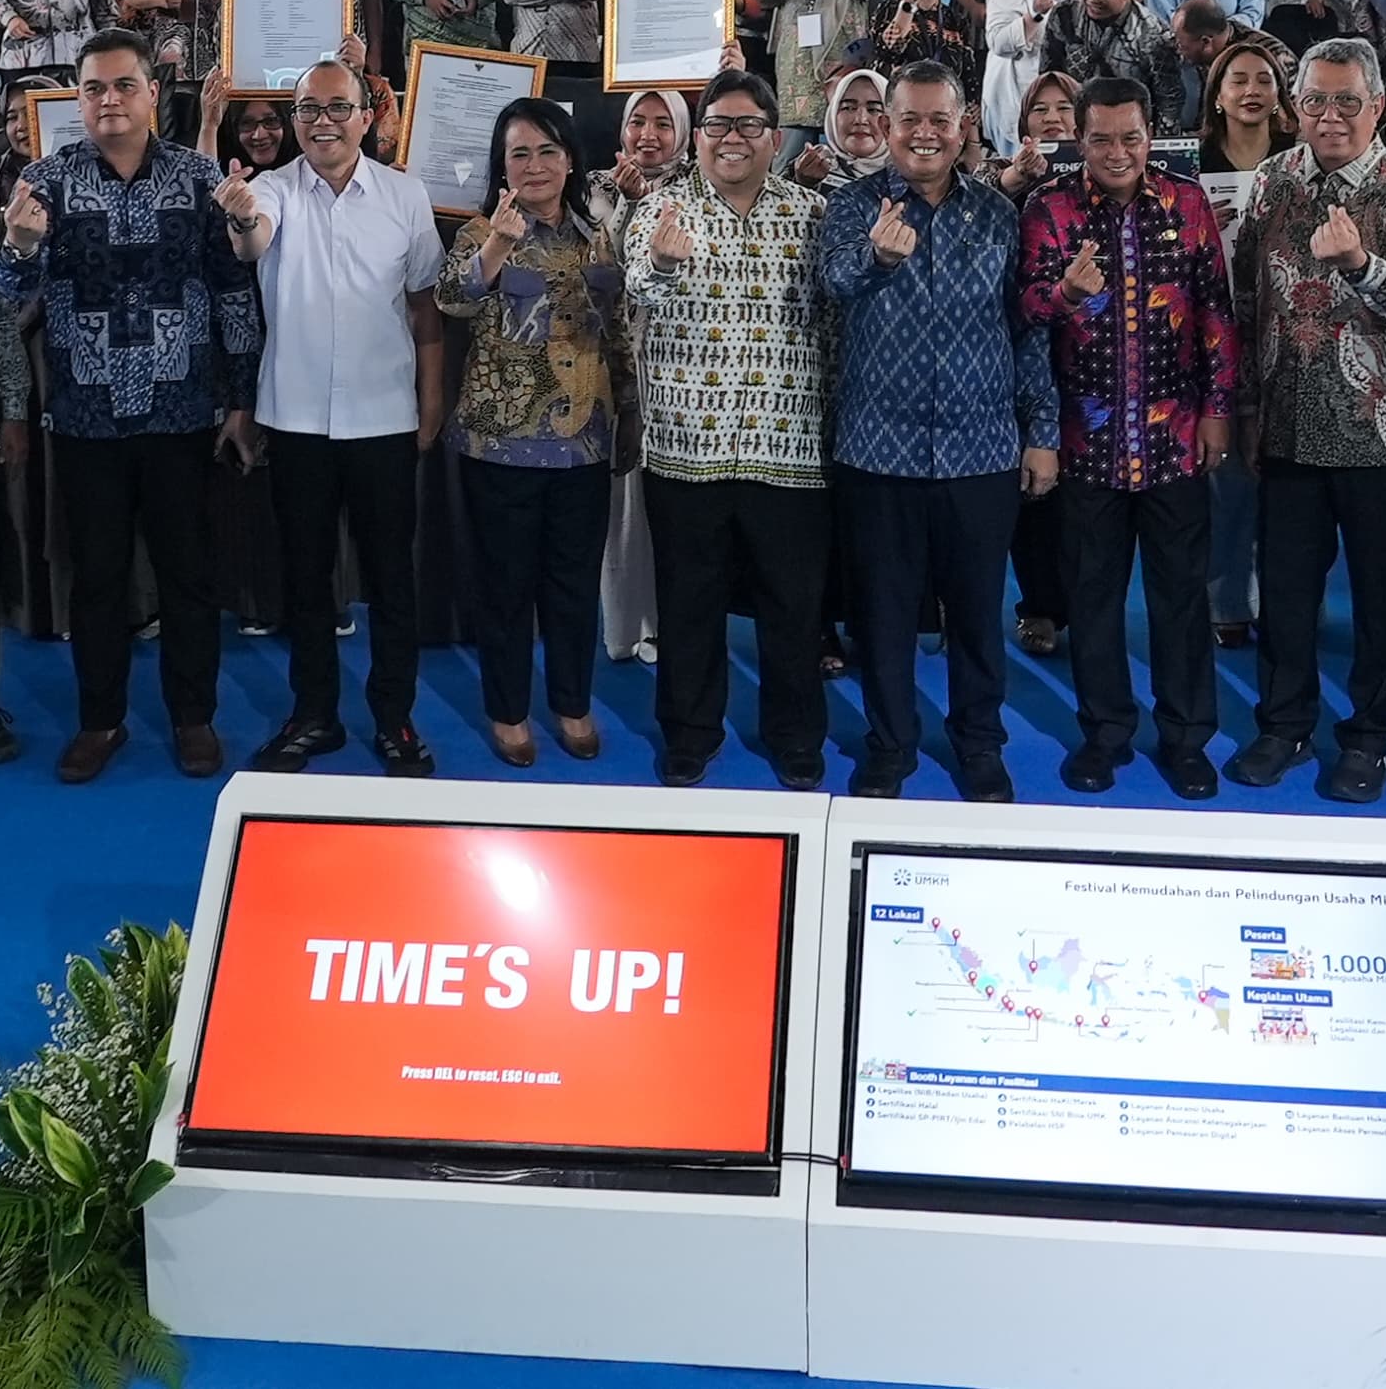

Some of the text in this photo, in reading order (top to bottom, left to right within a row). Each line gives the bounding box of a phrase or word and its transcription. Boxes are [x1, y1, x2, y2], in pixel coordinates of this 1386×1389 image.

[915, 874, 950, 887] UMKM
[1064, 880, 1117, 894] Festival
[1122, 882, 1201, 898] Kemudahan
[1206, 886, 1230, 899] dan
[1235, 888, 1320, 905] Pelindungan
[1324, 891, 1366, 905] Usaha
[875, 908, 921, 921] 12 Lokasi
[1244, 929, 1283, 941] Peserta
[569, 948, 685, 1015] UP!
[1323, 973, 1374, 983] Pengusaha
[1247, 990, 1330, 1004] Kegiatan Utama
[401, 1065, 562, 1084] Press DEL to reset, ESC to exit.
[909, 1071, 938, 1082] Booth
[939, 1073, 978, 1086] Layanan
[979, 1075, 997, 1086] dan
